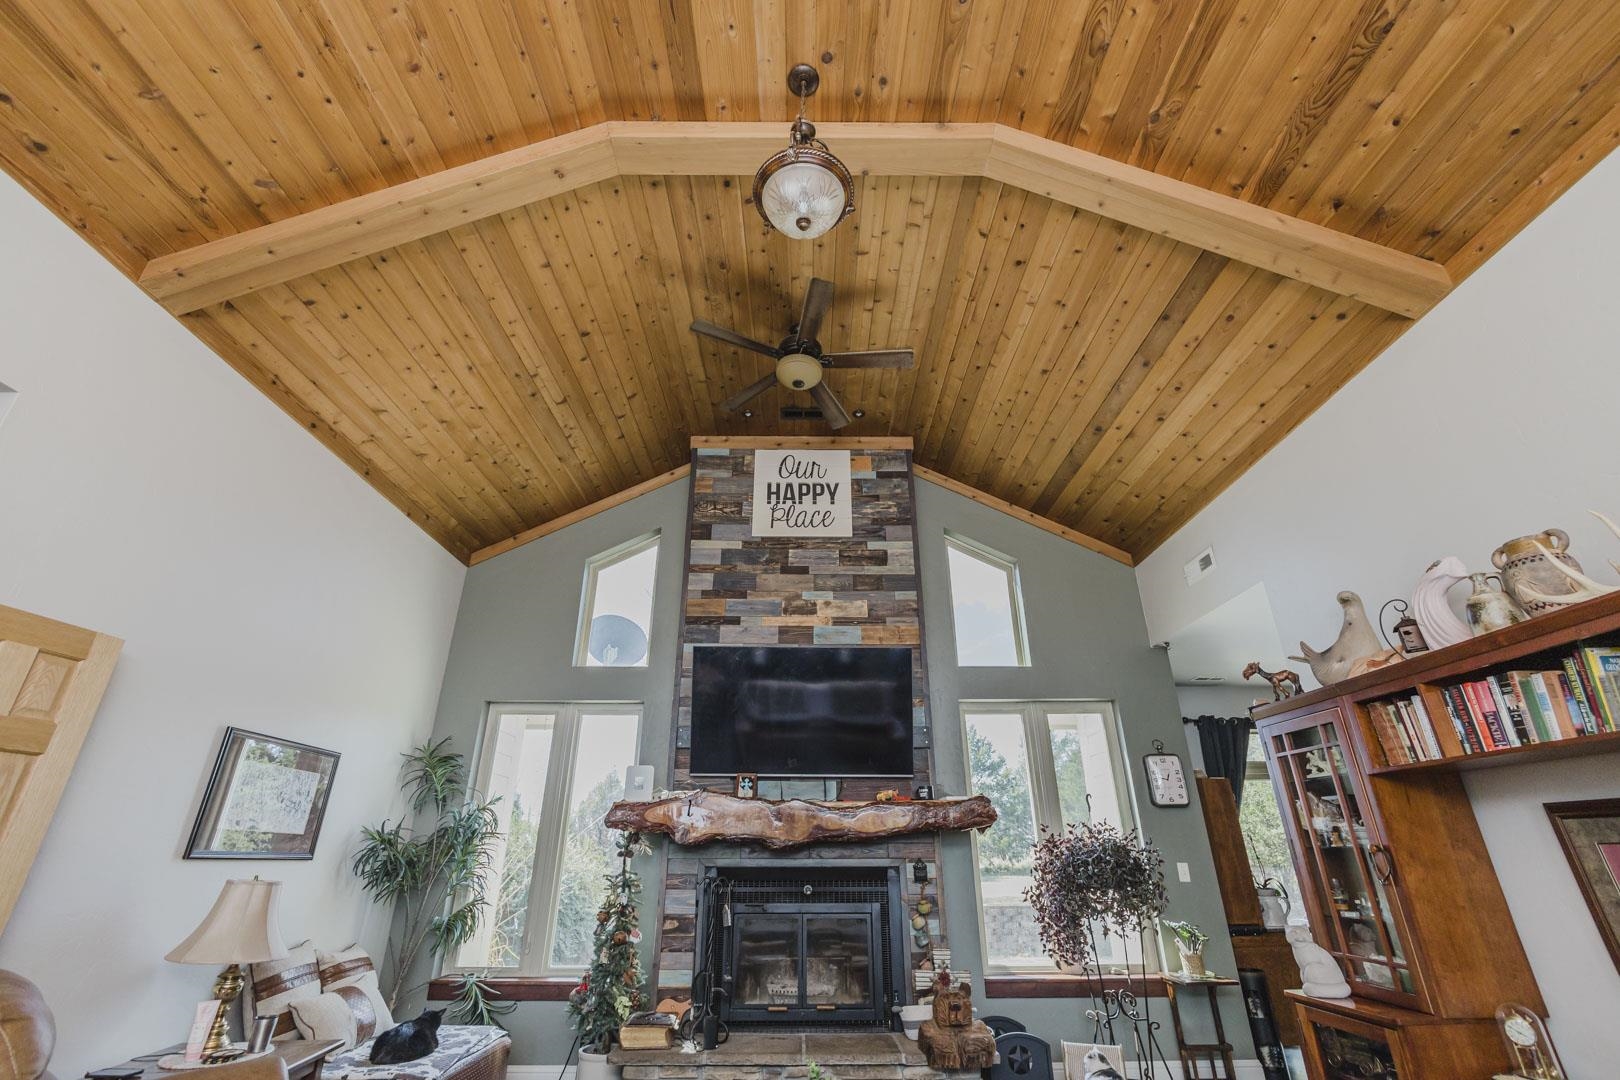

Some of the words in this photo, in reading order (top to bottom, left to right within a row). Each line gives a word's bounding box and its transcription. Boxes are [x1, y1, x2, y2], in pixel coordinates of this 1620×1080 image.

[778, 454, 827, 479] Our
[766, 482, 839, 505] HAPPY
[770, 503, 835, 528] Place
